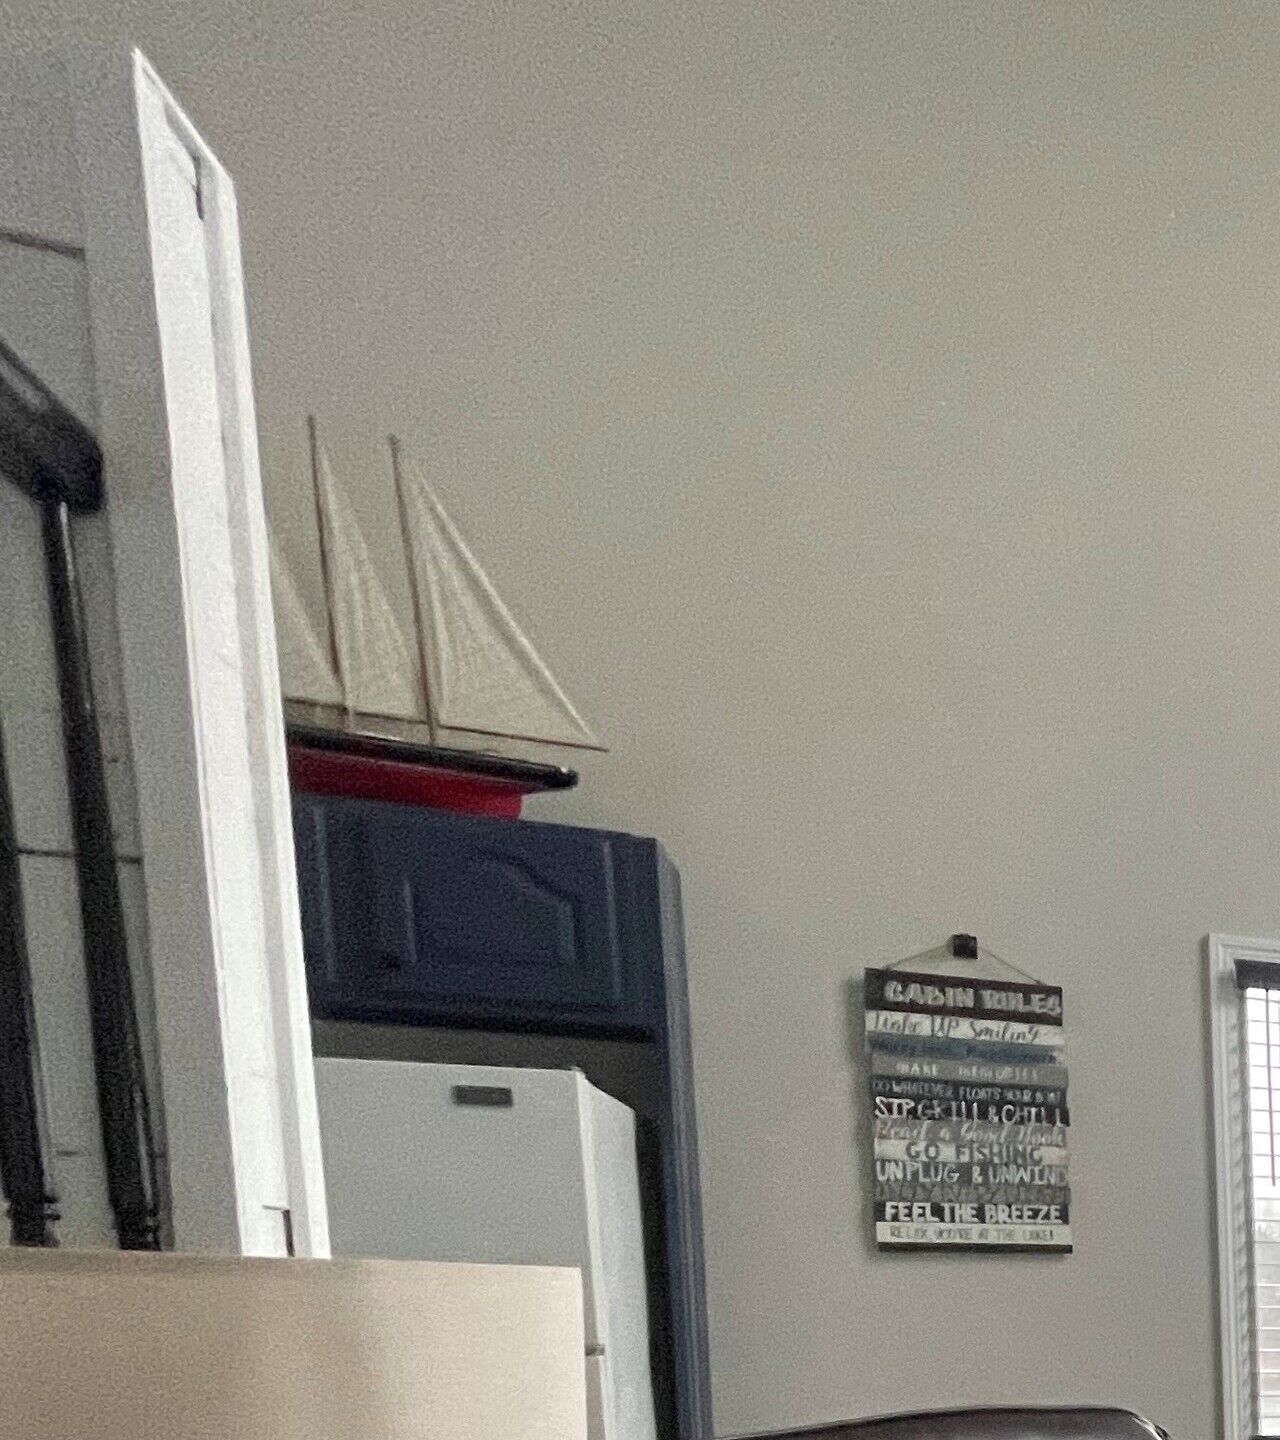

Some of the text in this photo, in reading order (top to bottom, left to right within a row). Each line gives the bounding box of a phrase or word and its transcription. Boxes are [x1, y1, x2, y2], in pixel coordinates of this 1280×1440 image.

[884, 979, 975, 1008] CABIN
[958, 1086, 1001, 1101] FLOATS
[917, 1099, 979, 1121] GRILL
[1001, 1104, 1070, 1126] CHILL
[905, 1142, 1043, 1166] GO FISHING
[875, 1160, 1068, 1187] UNPLUG & UNWIND
[884, 1201, 1063, 1225] FEEL THE BREEZE
